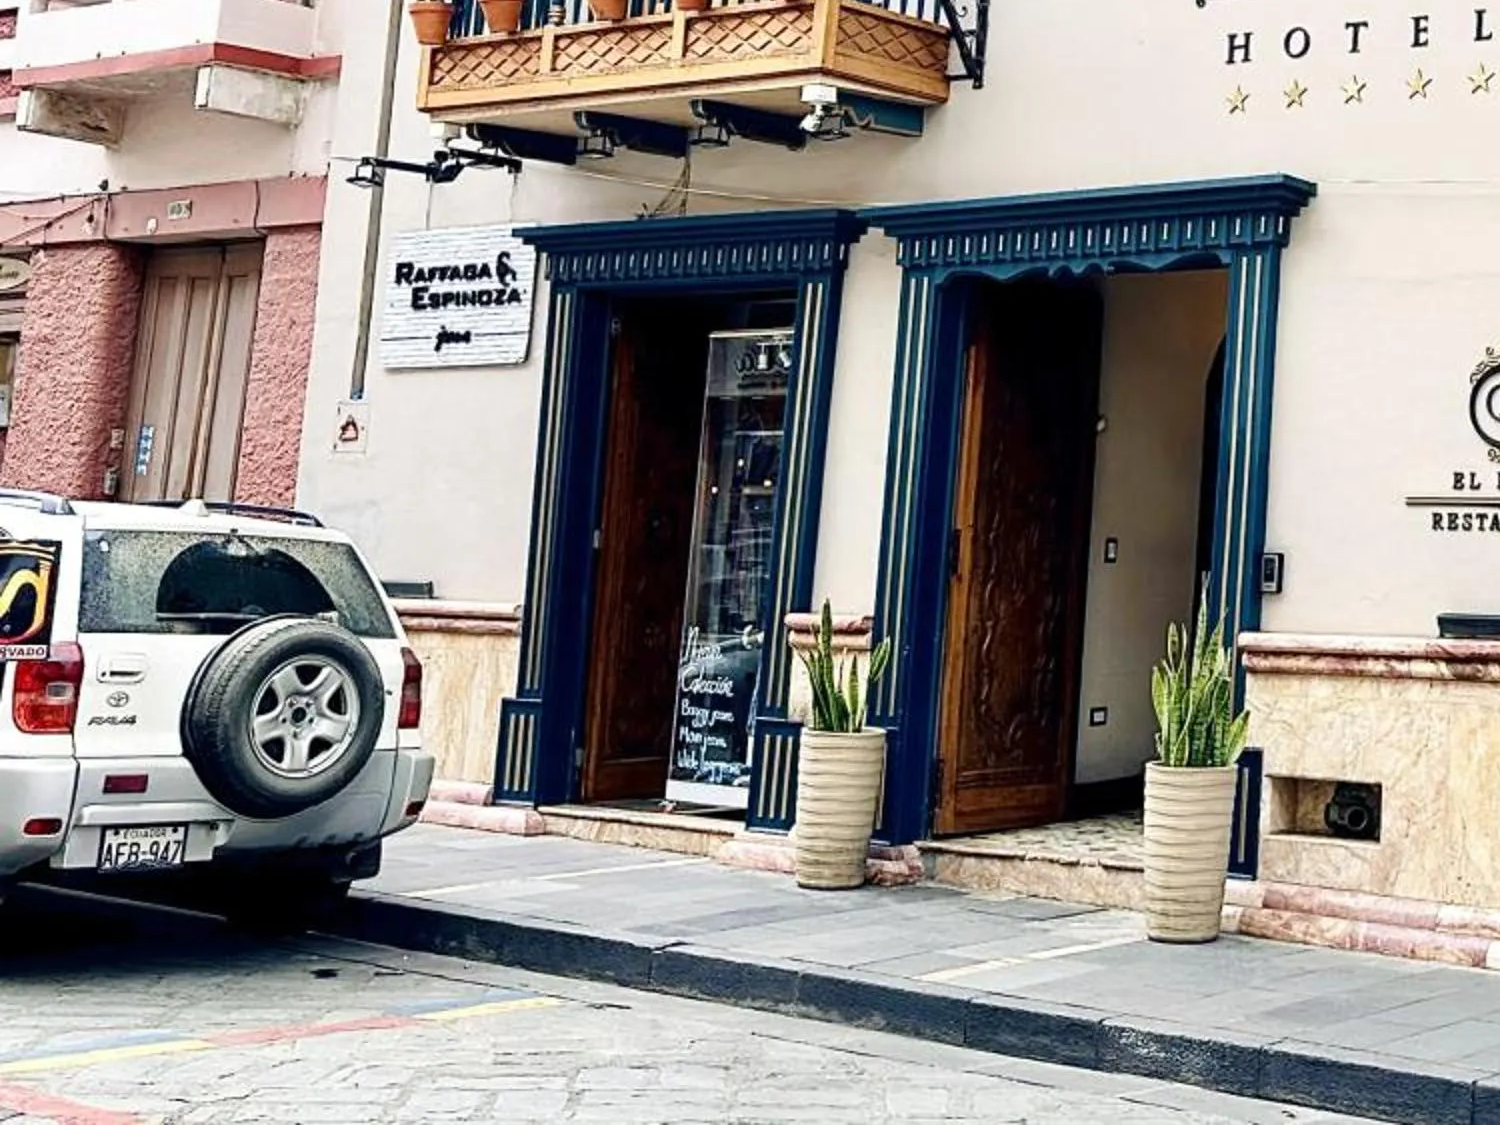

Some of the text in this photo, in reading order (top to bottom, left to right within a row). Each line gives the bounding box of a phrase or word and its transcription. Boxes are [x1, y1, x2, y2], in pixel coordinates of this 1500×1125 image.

[1225, 8, 1493, 64] HOTEL
[412, 286, 522, 311] ESPINOZA
[1453, 472, 1482, 491] EL
